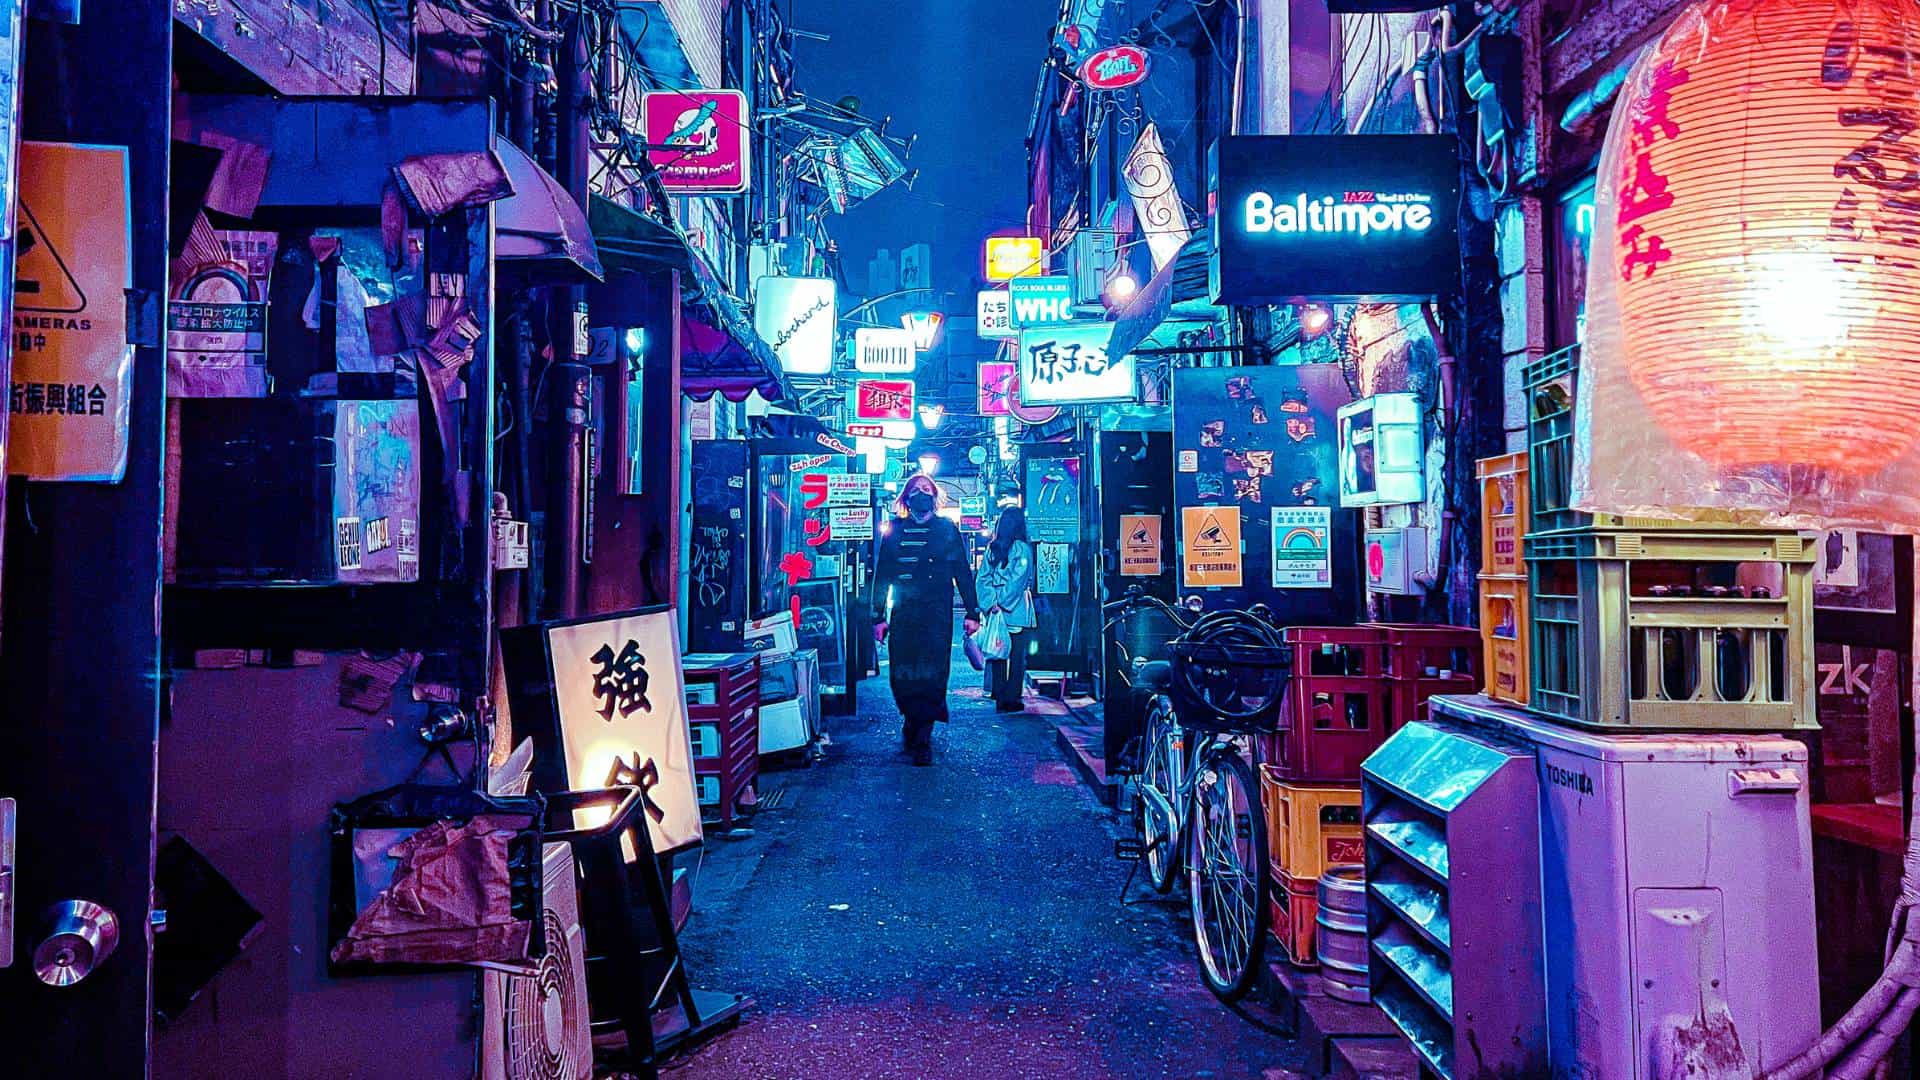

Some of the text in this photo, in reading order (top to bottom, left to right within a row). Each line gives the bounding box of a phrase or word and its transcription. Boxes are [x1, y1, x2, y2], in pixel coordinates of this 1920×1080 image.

[1343, 191, 1375, 202] JAZZ
[1245, 191, 1432, 235] Baltimore
[13, 332, 46, 352] 動中
[864, 346, 908, 365] BOOTH
